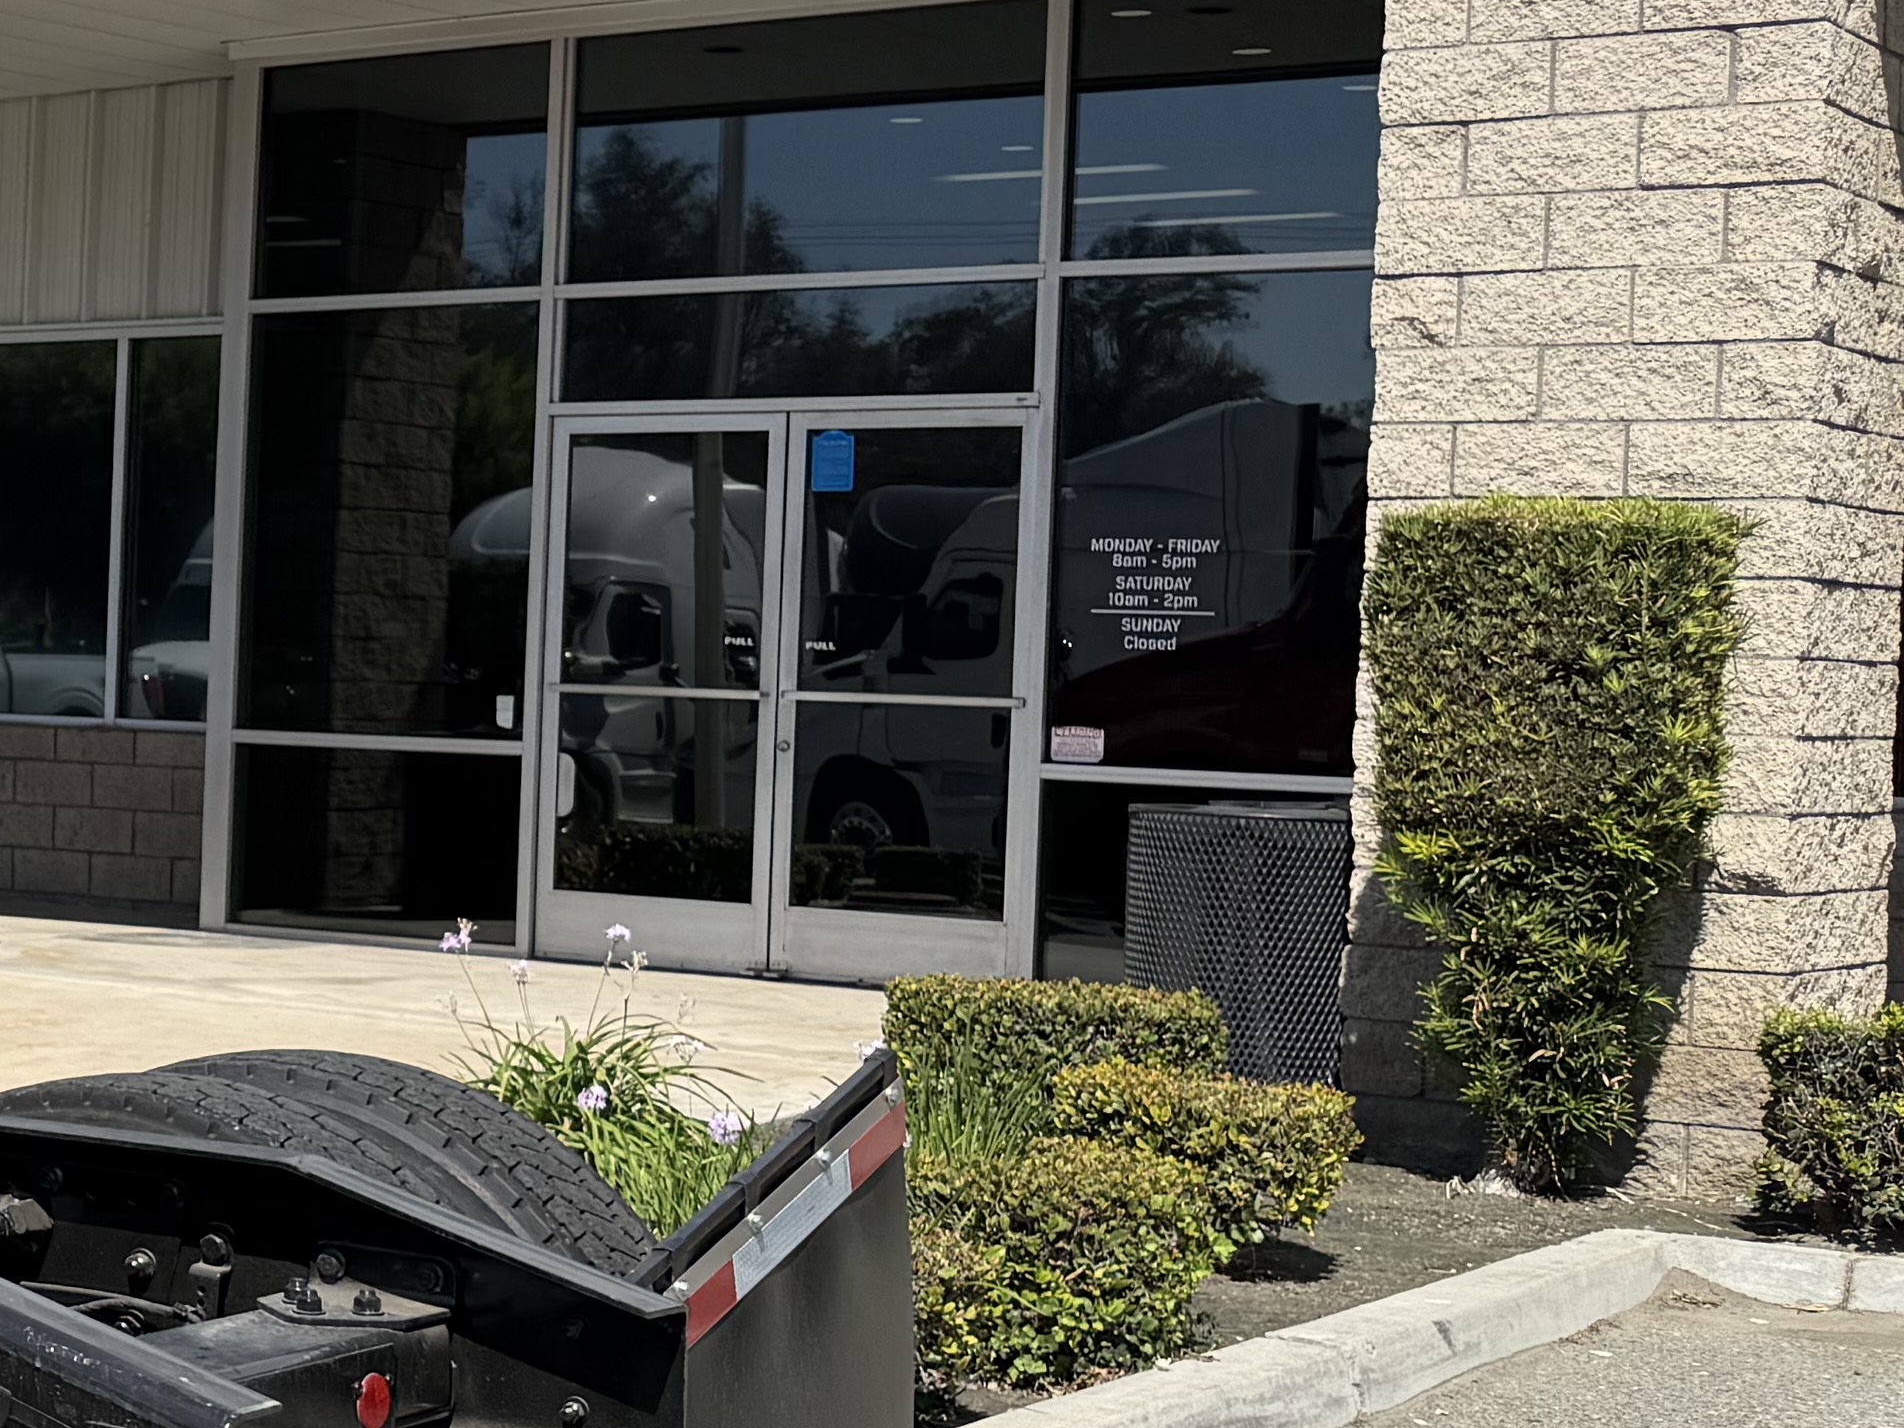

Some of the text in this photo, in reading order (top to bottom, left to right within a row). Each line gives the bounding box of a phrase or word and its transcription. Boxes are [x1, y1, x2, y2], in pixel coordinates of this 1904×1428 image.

[1091, 538, 1153, 553] MONDAY
[1168, 539, 1220, 554] FRIDAY
[1112, 554, 1147, 568] 8am
[1162, 555, 1197, 570] 5pm
[1115, 576, 1192, 591] SATURDAY
[1108, 592, 1149, 607] 10am
[1163, 594, 1198, 609] 2pm
[1121, 618, 1181, 633] SUNDAY
[724, 636, 754, 646] PULL
[805, 641, 836, 651] PULL
[1124, 635, 1177, 650] Closed
